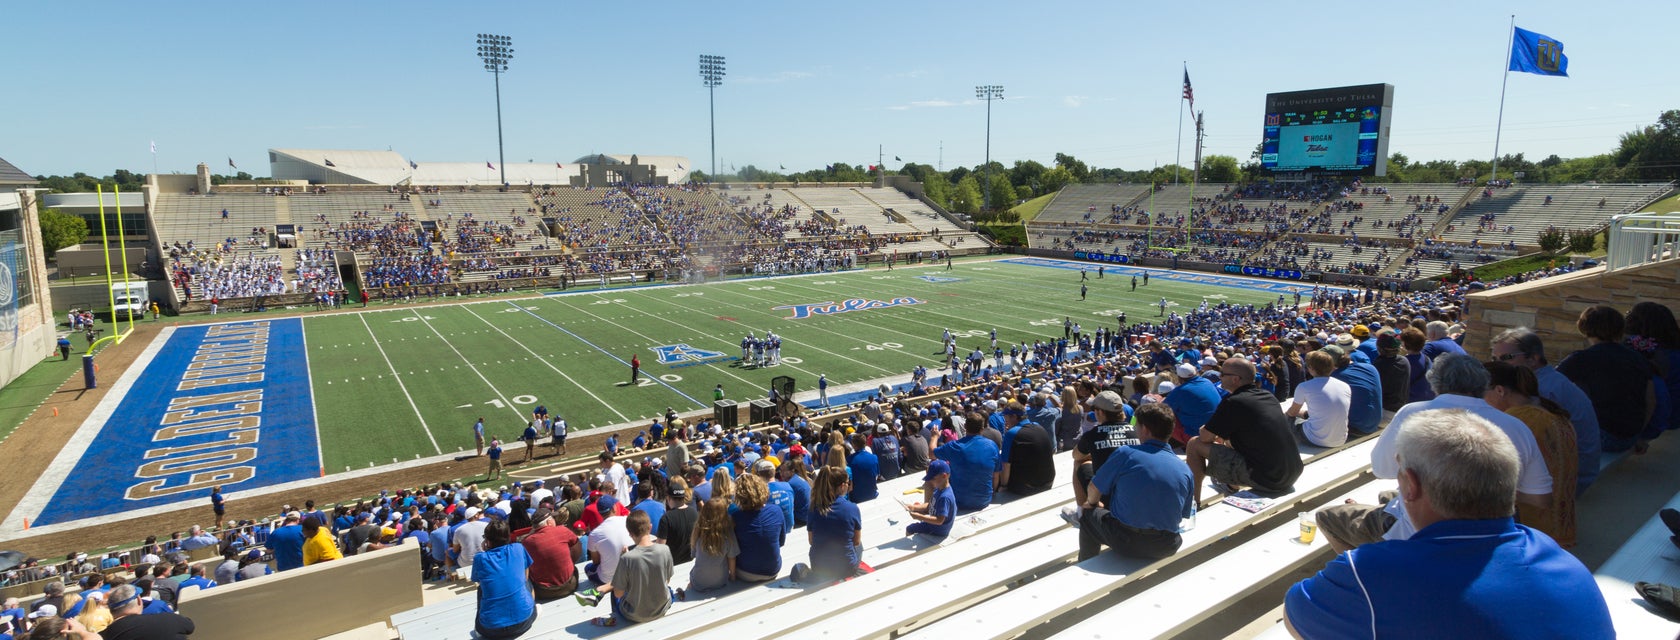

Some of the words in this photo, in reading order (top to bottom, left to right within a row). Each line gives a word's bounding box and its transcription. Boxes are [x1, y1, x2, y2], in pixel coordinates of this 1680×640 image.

[1289, 97, 1336, 105] UNIVERSITY
[1310, 134, 1333, 142] HOGAN
[1224, 265, 1240, 273] COX
[770, 296, 928, 320] Tulsa
[866, 341, 904, 352] 40
[176, 321, 271, 391] HURRICANE
[636, 374, 683, 387] 20
[484, 394, 538, 409] 10
[1097, 424, 1135, 433] PROTECT
[1107, 430, 1126, 439] THE
[124, 389, 264, 501] GOLDEN
[1094, 438, 1141, 449] TRADITION
